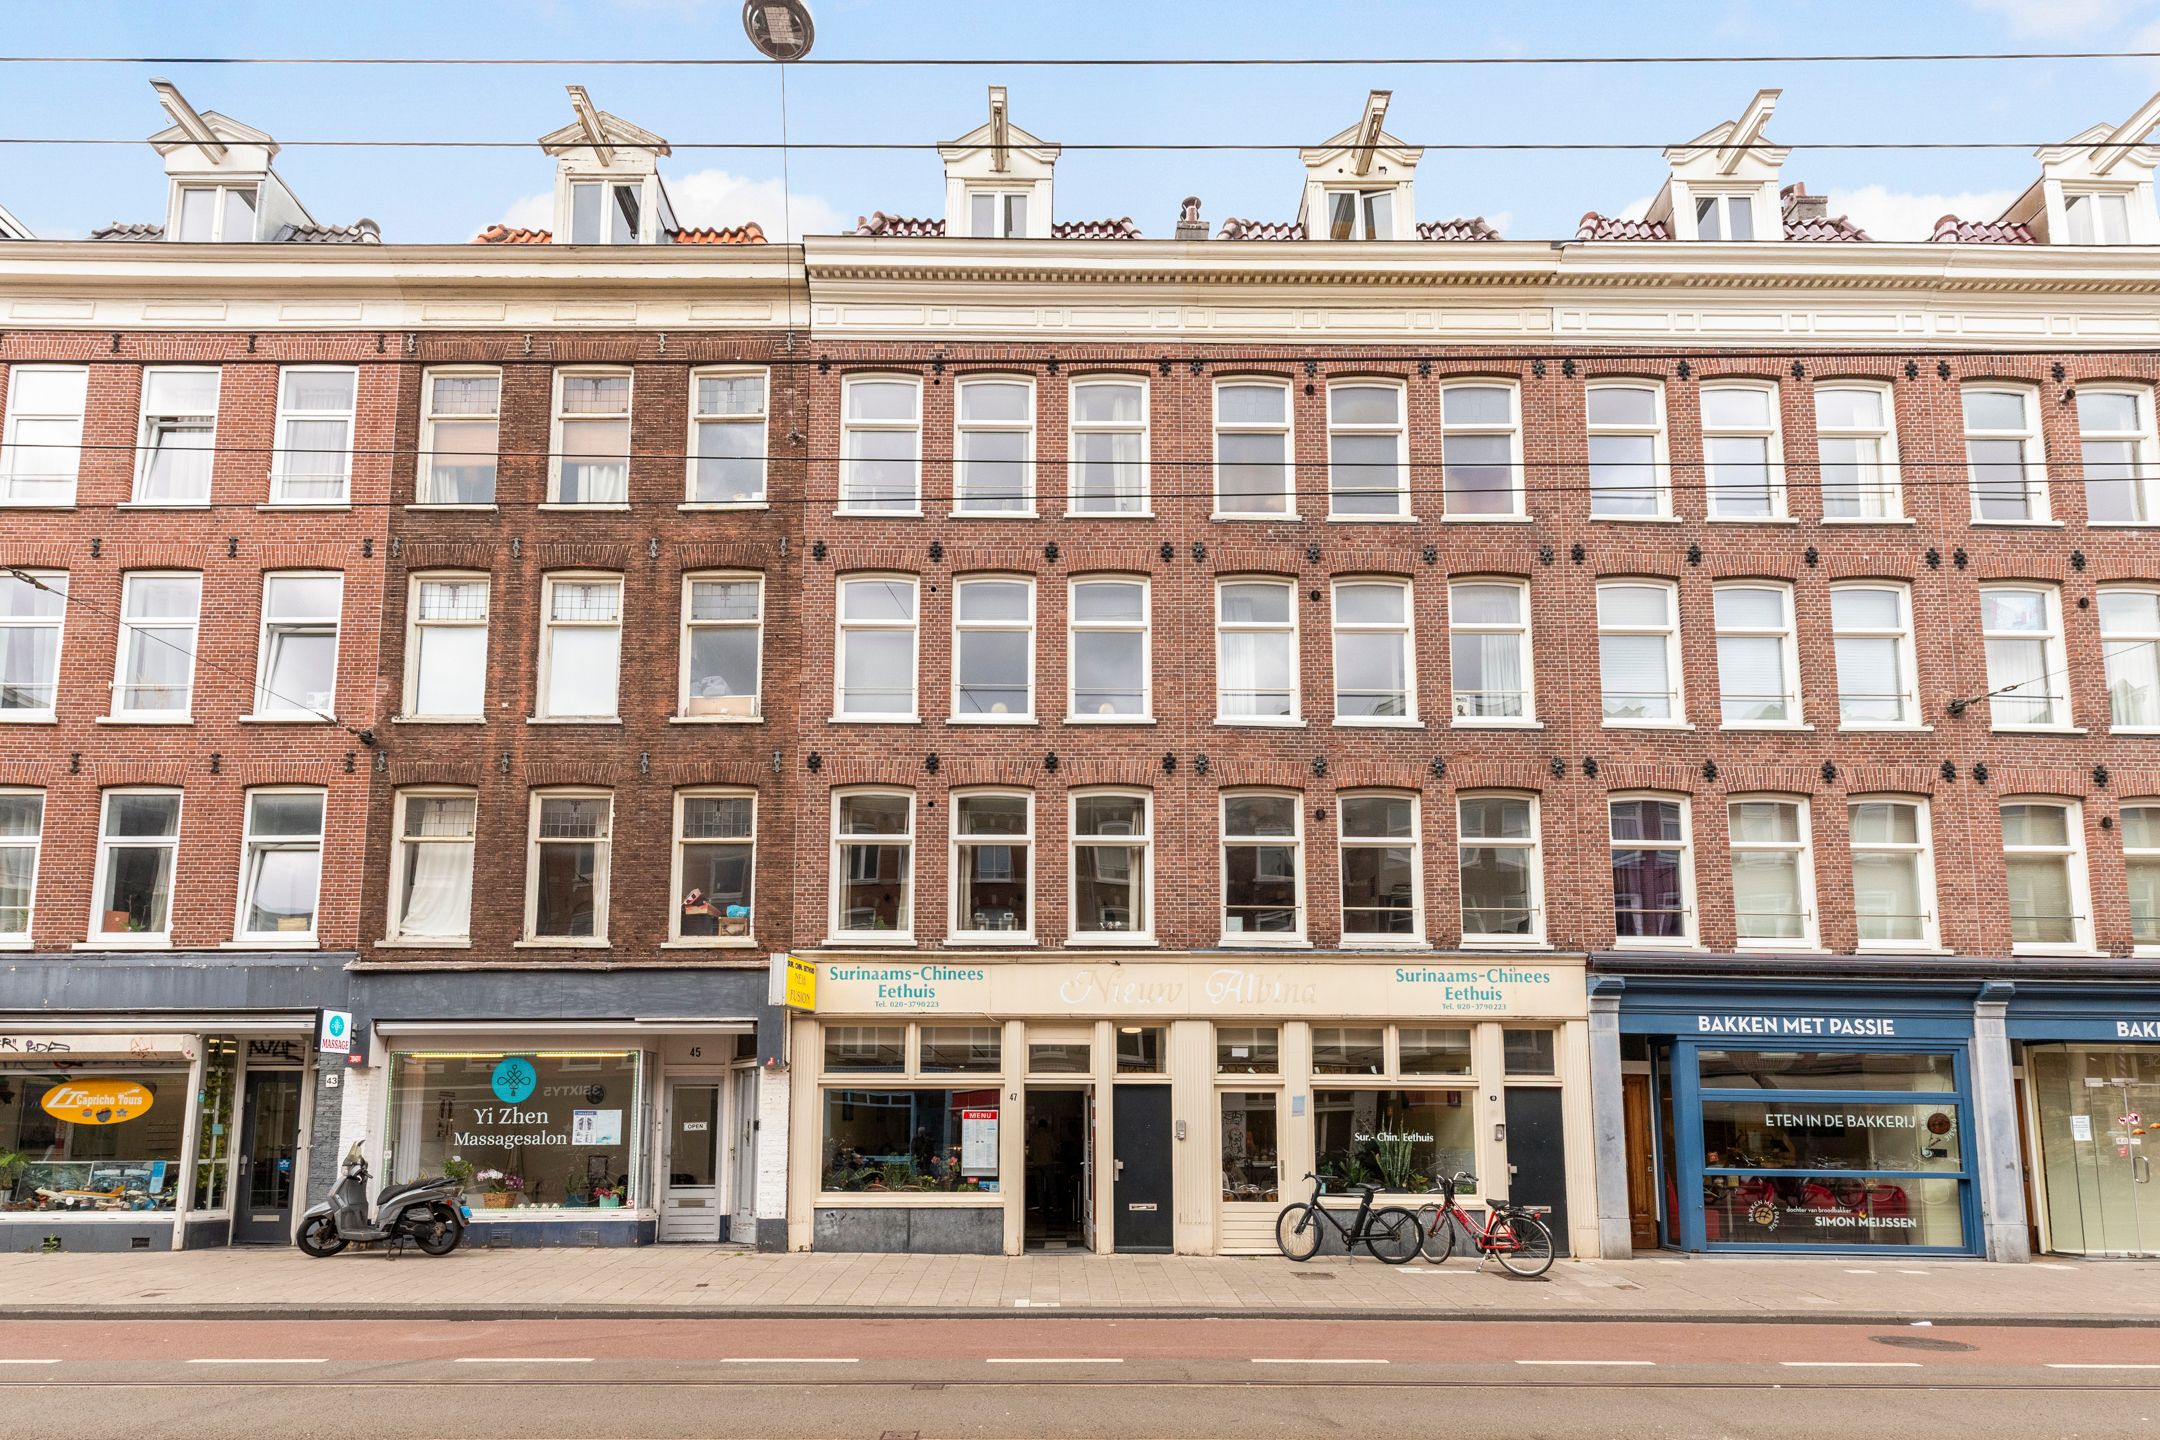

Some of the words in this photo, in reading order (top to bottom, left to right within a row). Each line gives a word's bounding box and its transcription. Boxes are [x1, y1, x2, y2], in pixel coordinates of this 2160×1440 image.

[830, 966, 984, 981] Surinaams-Chinees
[1395, 968, 1550, 983] Surinaams-Chinees
[878, 984, 936, 998] Eethuis
[1060, 968, 1184, 1005] Nieuw
[1445, 986, 1503, 1001] Eethuis
[1698, 1015, 1778, 1033] BAKKEN
[1783, 1017, 1825, 1034] MET
[1830, 1018, 1895, 1036] PASSIE
[322, 1038, 349, 1050] MASSAGE
[690, 1047, 701, 1057] 45
[326, 1077, 338, 1085] 43
[76, 1093, 115, 1107] Capricho
[118, 1093, 143, 1105] Tours
[1010, 1092, 1018, 1101] 47
[474, 1107, 493, 1125] Yi
[500, 1107, 549, 1125] Zhen
[1765, 1114, 1803, 1127] ETEN
[1807, 1114, 1822, 1127] IN
[1824, 1115, 1844, 1128] DE
[1847, 1115, 1916, 1129] BAKKERIJ
[454, 1130, 567, 1149] Massagesalon
[1377, 1131, 1400, 1142] Chin.
[1403, 1132, 1434, 1143] Eethuis
[1786, 1205, 1807, 1213] dochter
[1818, 1206, 1852, 1214] broodbakker
[1815, 1216, 1855, 1227] SIMON
[1859, 1217, 1917, 1228] MEIJSSEN
